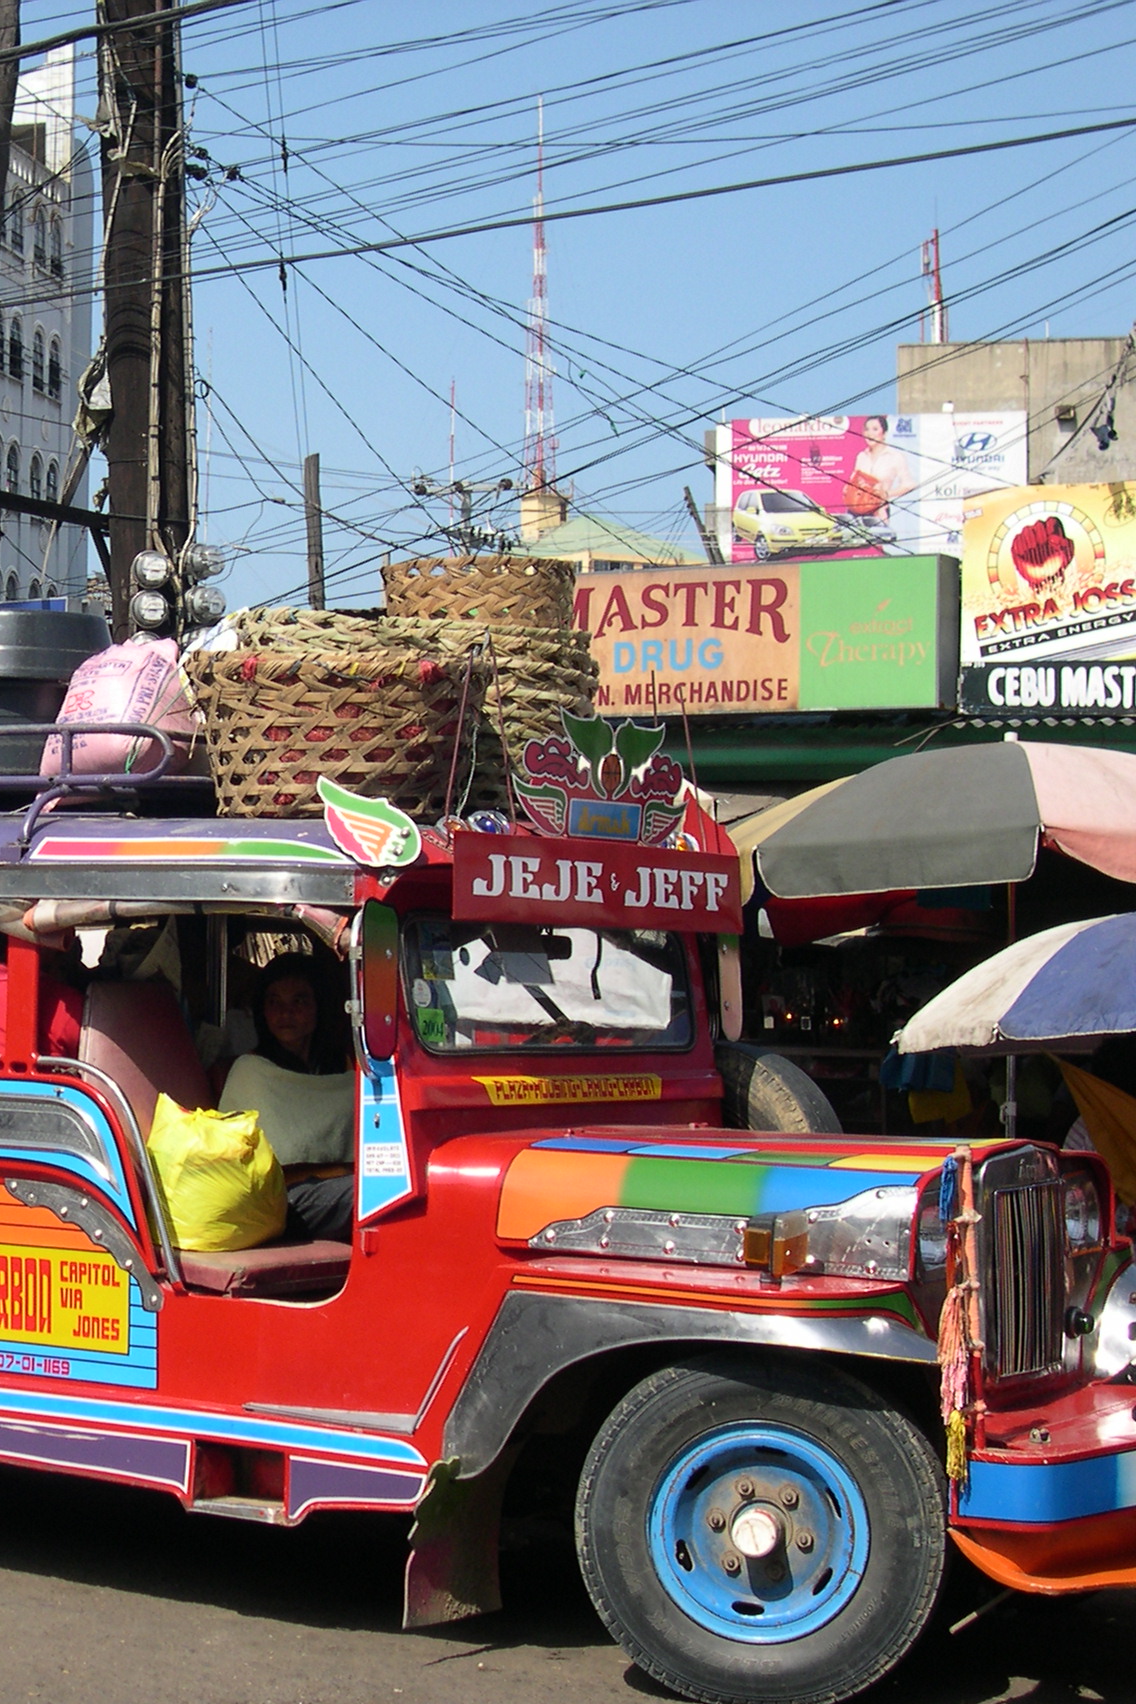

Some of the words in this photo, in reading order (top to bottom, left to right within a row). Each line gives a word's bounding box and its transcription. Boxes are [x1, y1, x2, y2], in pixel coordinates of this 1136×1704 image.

[734, 453, 788, 463] HYUNDAI
[952, 454, 1004, 463] HYUNDAI
[974, 598, 1063, 641] EXTRA
[1070, 579, 1136, 618] JOSS
[806, 631, 931, 667] Therapy
[987, 633, 1051, 653] EXTRA
[1057, 613, 1135, 637] ENERGY
[614, 637, 724, 673] DRUG
[625, 678, 788, 706] MERCHANDISE
[987, 666, 1056, 706] CEBU
[1061, 666, 1136, 709] MAST
[473, 854, 604, 903] JEJE
[611, 873, 620, 891] &
[624, 867, 728, 911] JEFF
[60, 1260, 121, 1287] CAPITOL
[61, 1287, 83, 1310] VIA
[72, 1318, 121, 1342] JONES
